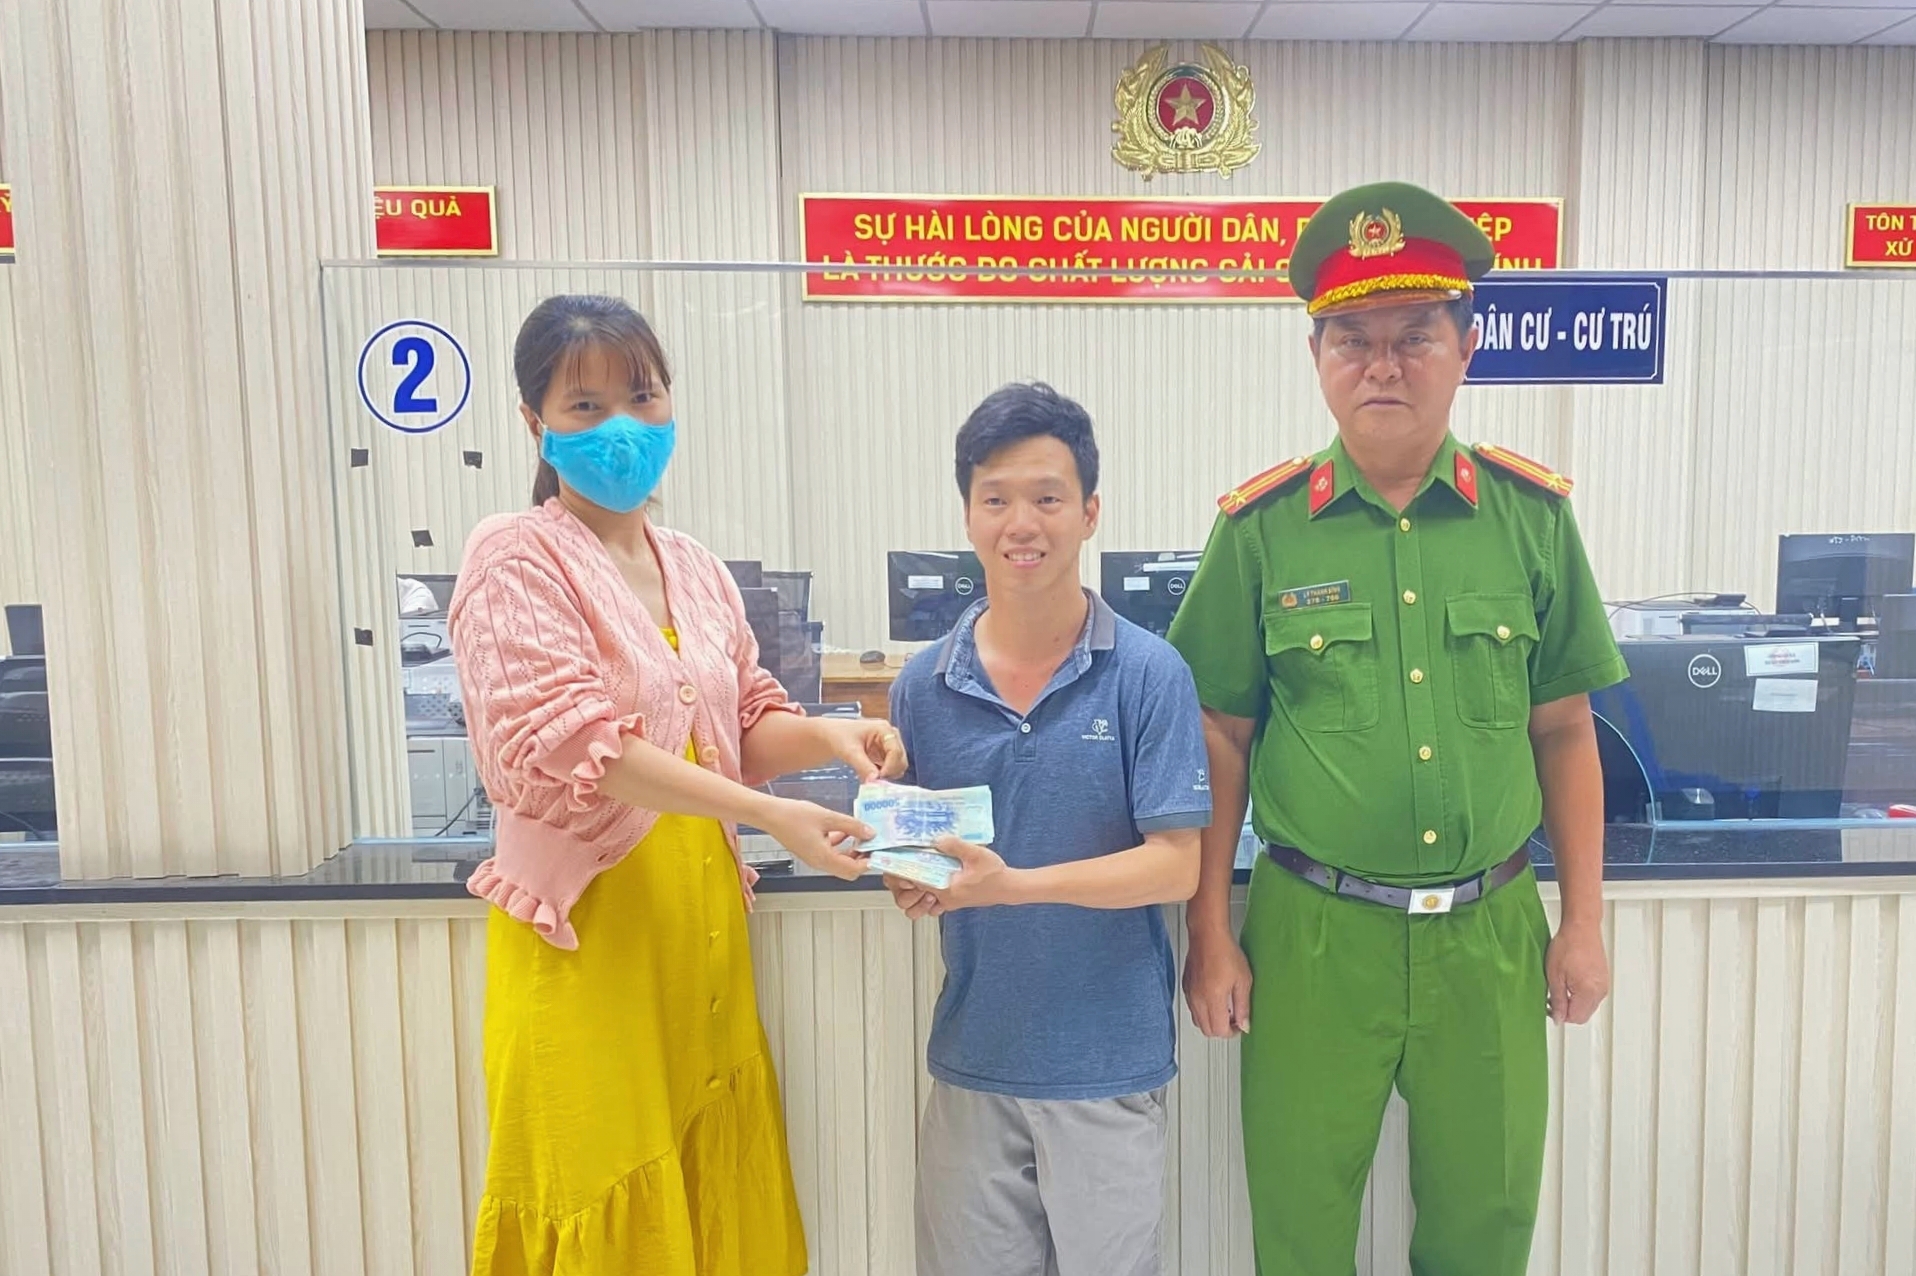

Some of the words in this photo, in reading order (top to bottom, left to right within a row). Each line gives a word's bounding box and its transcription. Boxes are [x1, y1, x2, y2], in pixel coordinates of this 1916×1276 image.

[854, 213, 897, 245] SỰ
[905, 209, 954, 240] HÀI
[965, 210, 1043, 241] LÒNG
[1053, 209, 1112, 242] CỦA
[1121, 212, 1211, 242] NGƯỜI
[1222, 212, 1286, 247] DÂN,
[1865, 212, 1904, 231] TÔN
[1885, 237, 1914, 256] XỬ
[823, 250, 859, 281] LÀ
[865, 251, 967, 282] THƯỚC
[1028, 249, 1102, 282] CHẤT
[1111, 256, 1208, 289] LƯỢNG
[1520, 306, 1552, 350] CƯ
[1573, 306, 1605, 350] CƯ
[1610, 303, 1651, 350] TRÚ
[392, 337, 437, 413] 2
[1692, 666, 1717, 676] DELL
